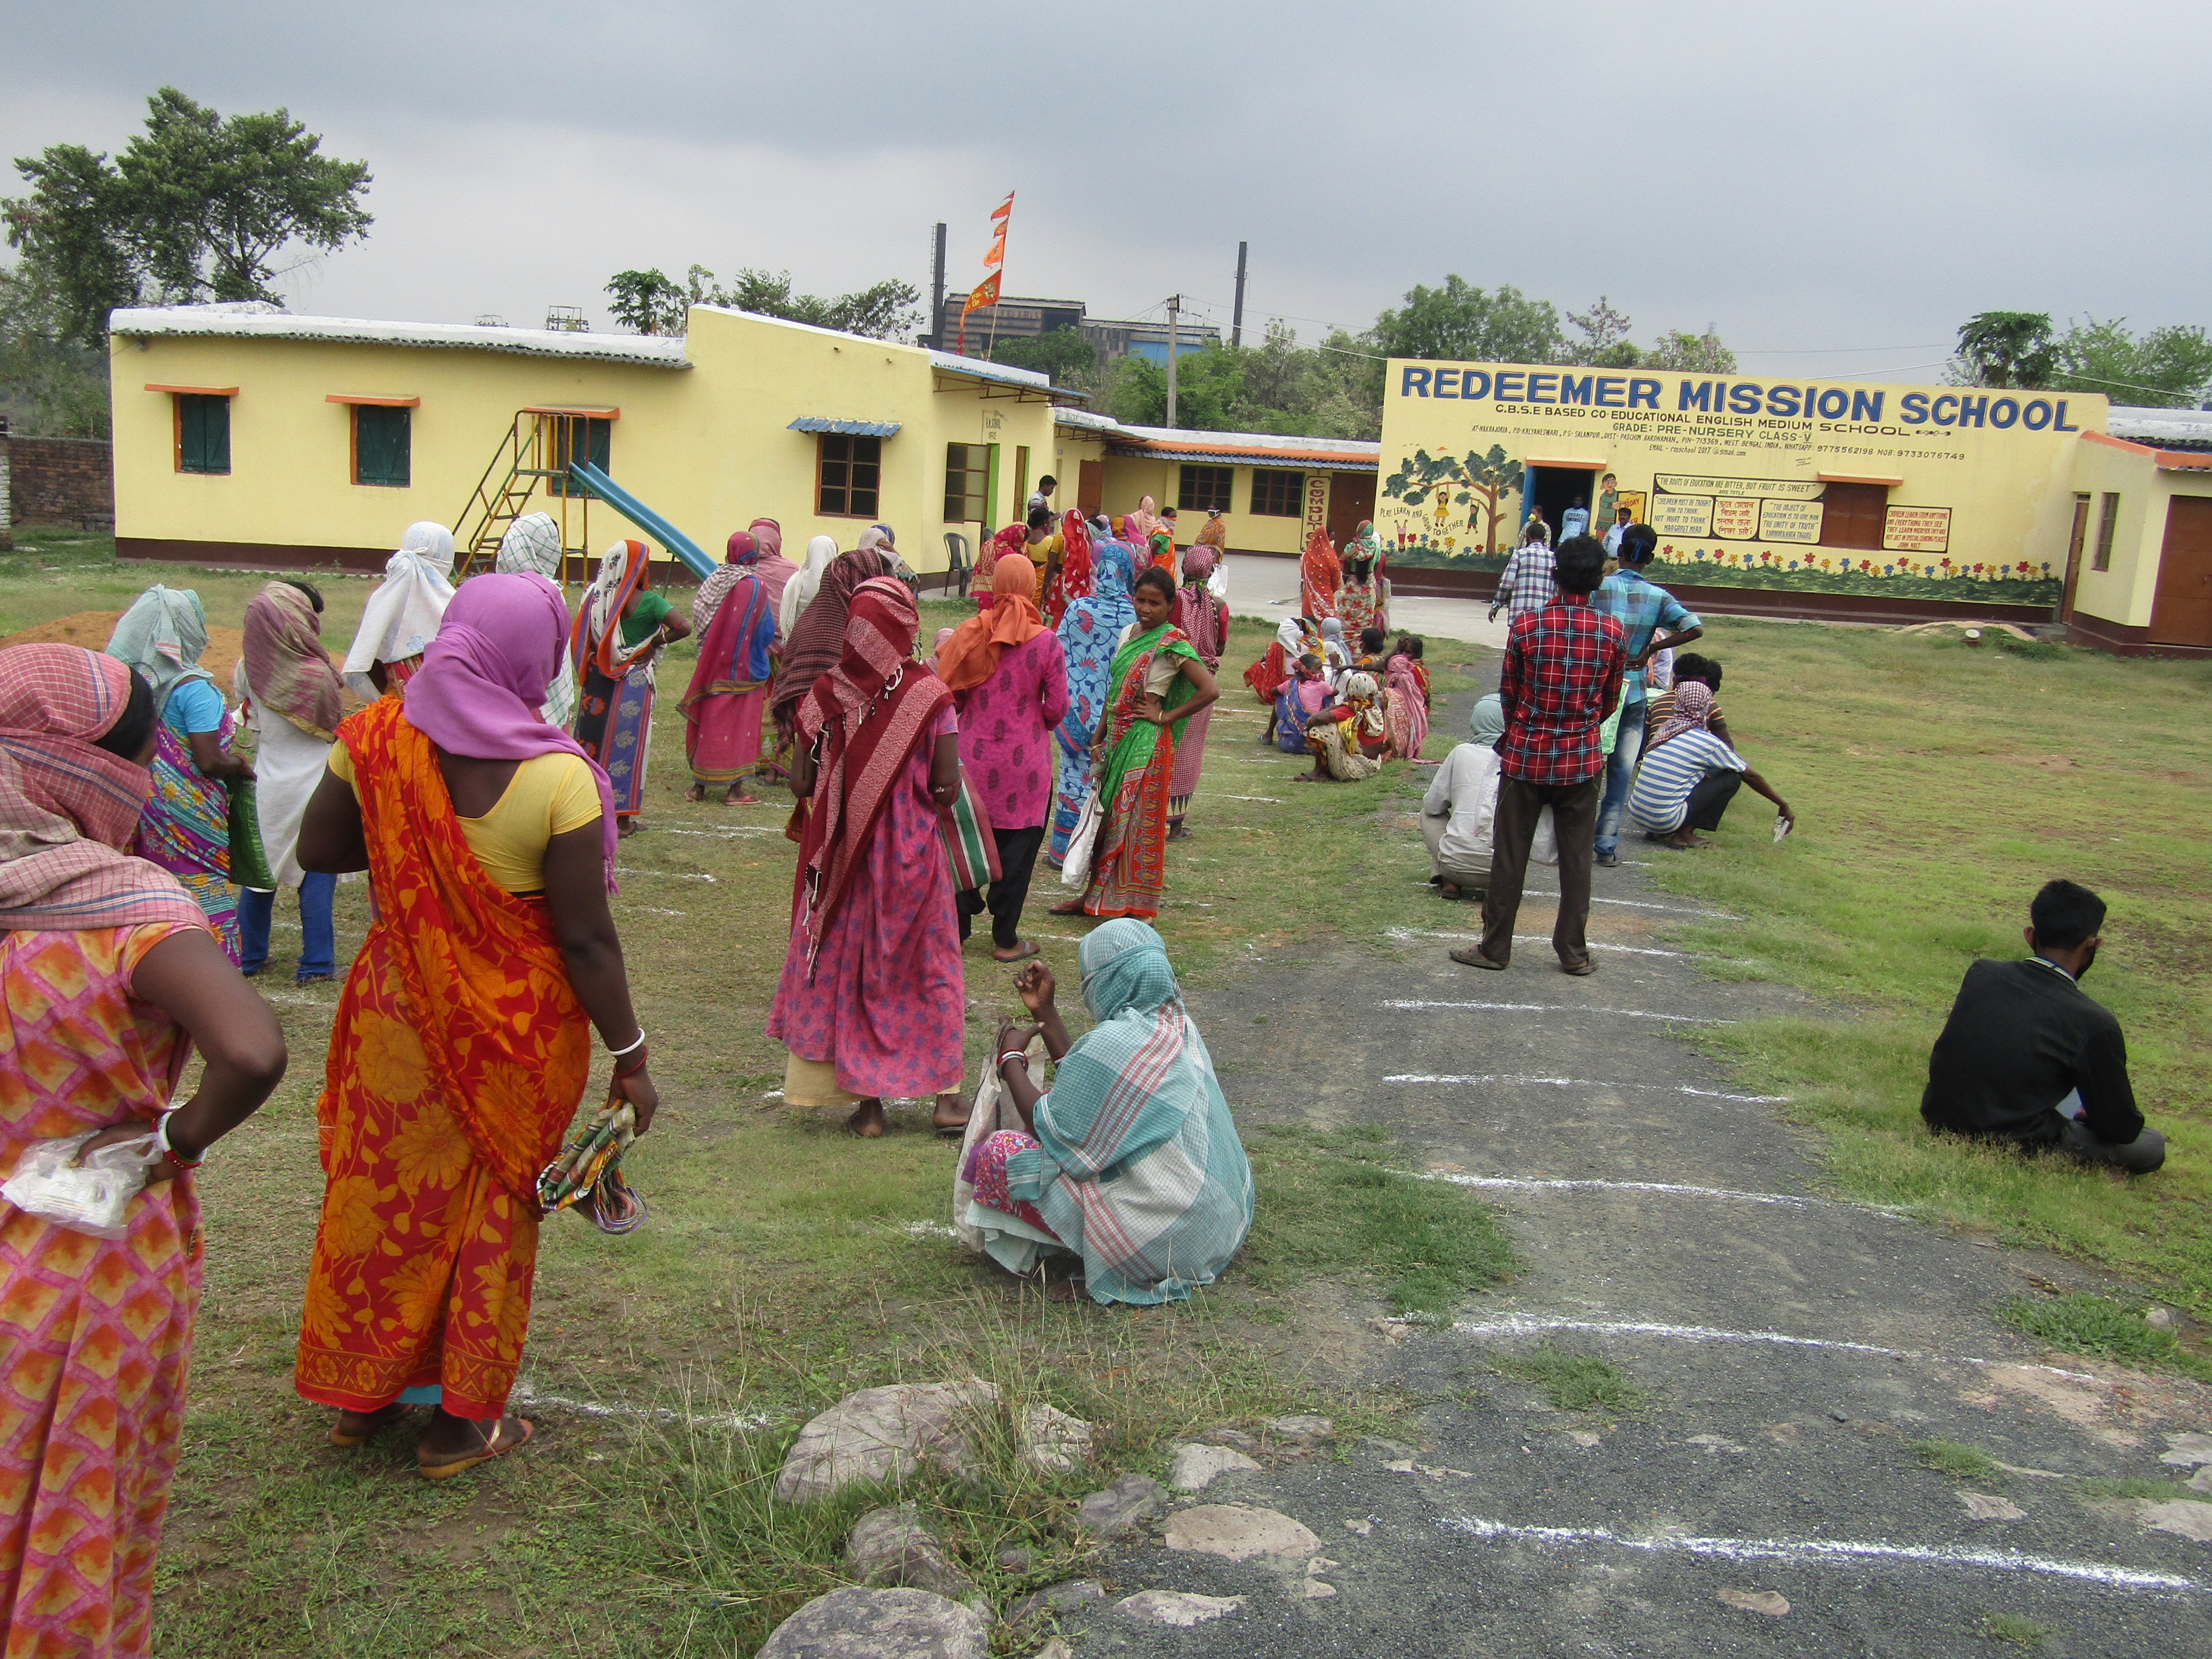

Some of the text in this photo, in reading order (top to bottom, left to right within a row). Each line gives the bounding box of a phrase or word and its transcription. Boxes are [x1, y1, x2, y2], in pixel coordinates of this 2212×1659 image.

[1401, 366, 2079, 432] REDEEMER MISSION SCHOOL
[1495, 404, 1541, 415] C.B.S.E
[1545, 406, 1586, 418] BASED
[1696, 415, 1752, 427] ENGLISH
[1758, 418, 1812, 431] MEDIUM
[1819, 423, 1911, 436] SCHOOL
[1613, 423, 1652, 432] GRADE:
[1657, 425, 1754, 438] PRE-NURSERY
[1817, 445, 1874, 455] 9775562198
[1897, 450, 1965, 460] 9733076749
[1669, 477, 1683, 486] ROOTS
[1689, 478, 1714, 488] EDUCATION
[1758, 483, 1777, 491] FRUIT
[1305, 480, 1325, 549] COMPUTE
[1393, 507, 1410, 517] LEARN
[1412, 510, 1423, 518] AND
[1422, 514, 1432, 532] GROW
[1433, 520, 1464, 536] TOGETHER
